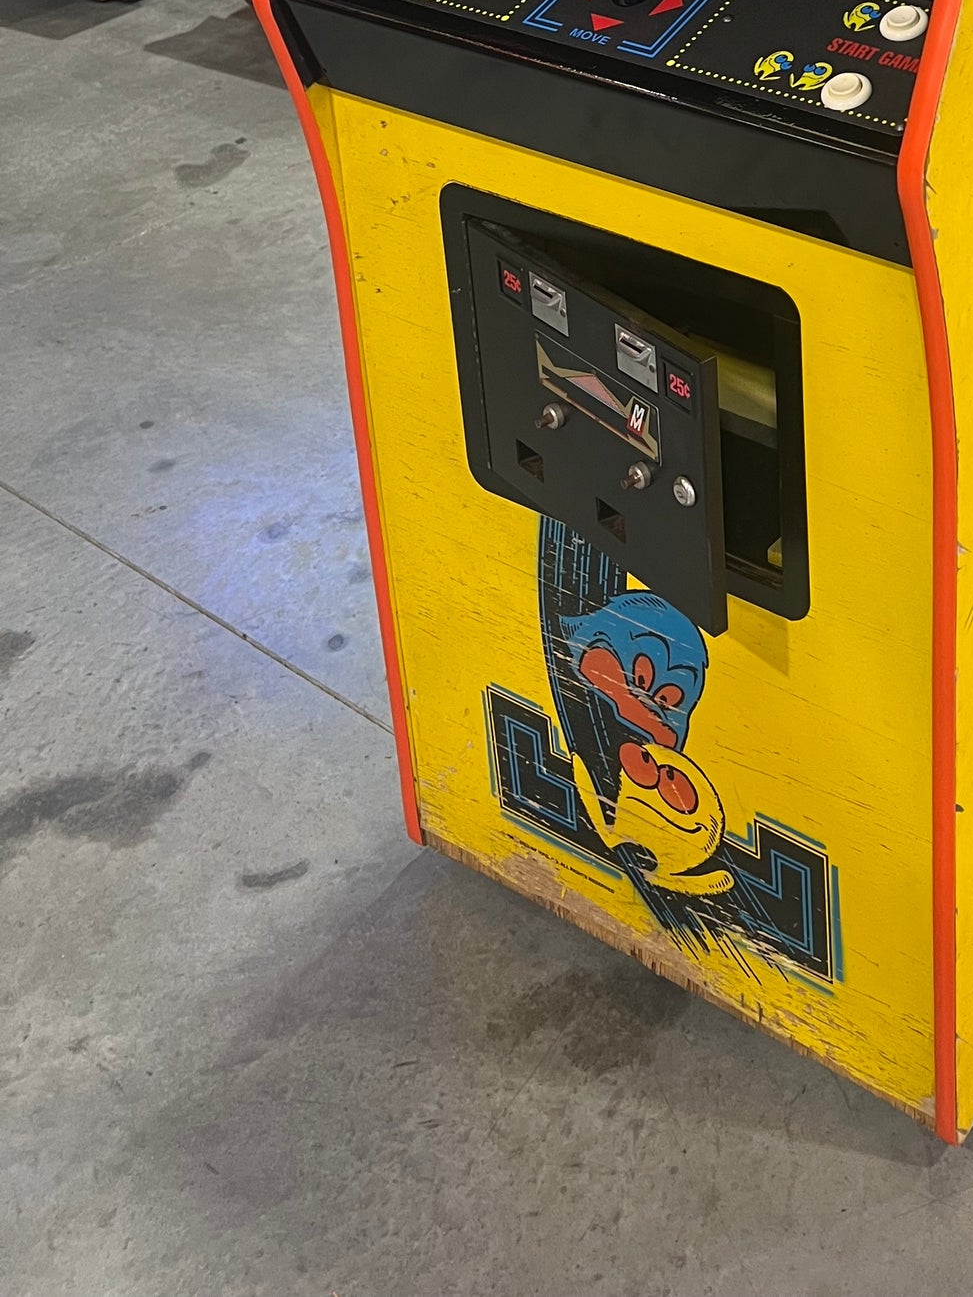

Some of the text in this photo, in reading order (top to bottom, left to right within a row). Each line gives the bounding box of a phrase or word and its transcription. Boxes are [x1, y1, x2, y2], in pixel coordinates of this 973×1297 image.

[568, 27, 612, 48] MOVE
[826, 37, 880, 62] START
[503, 269, 522, 294] 25¢
[669, 373, 692, 400] 25¢
